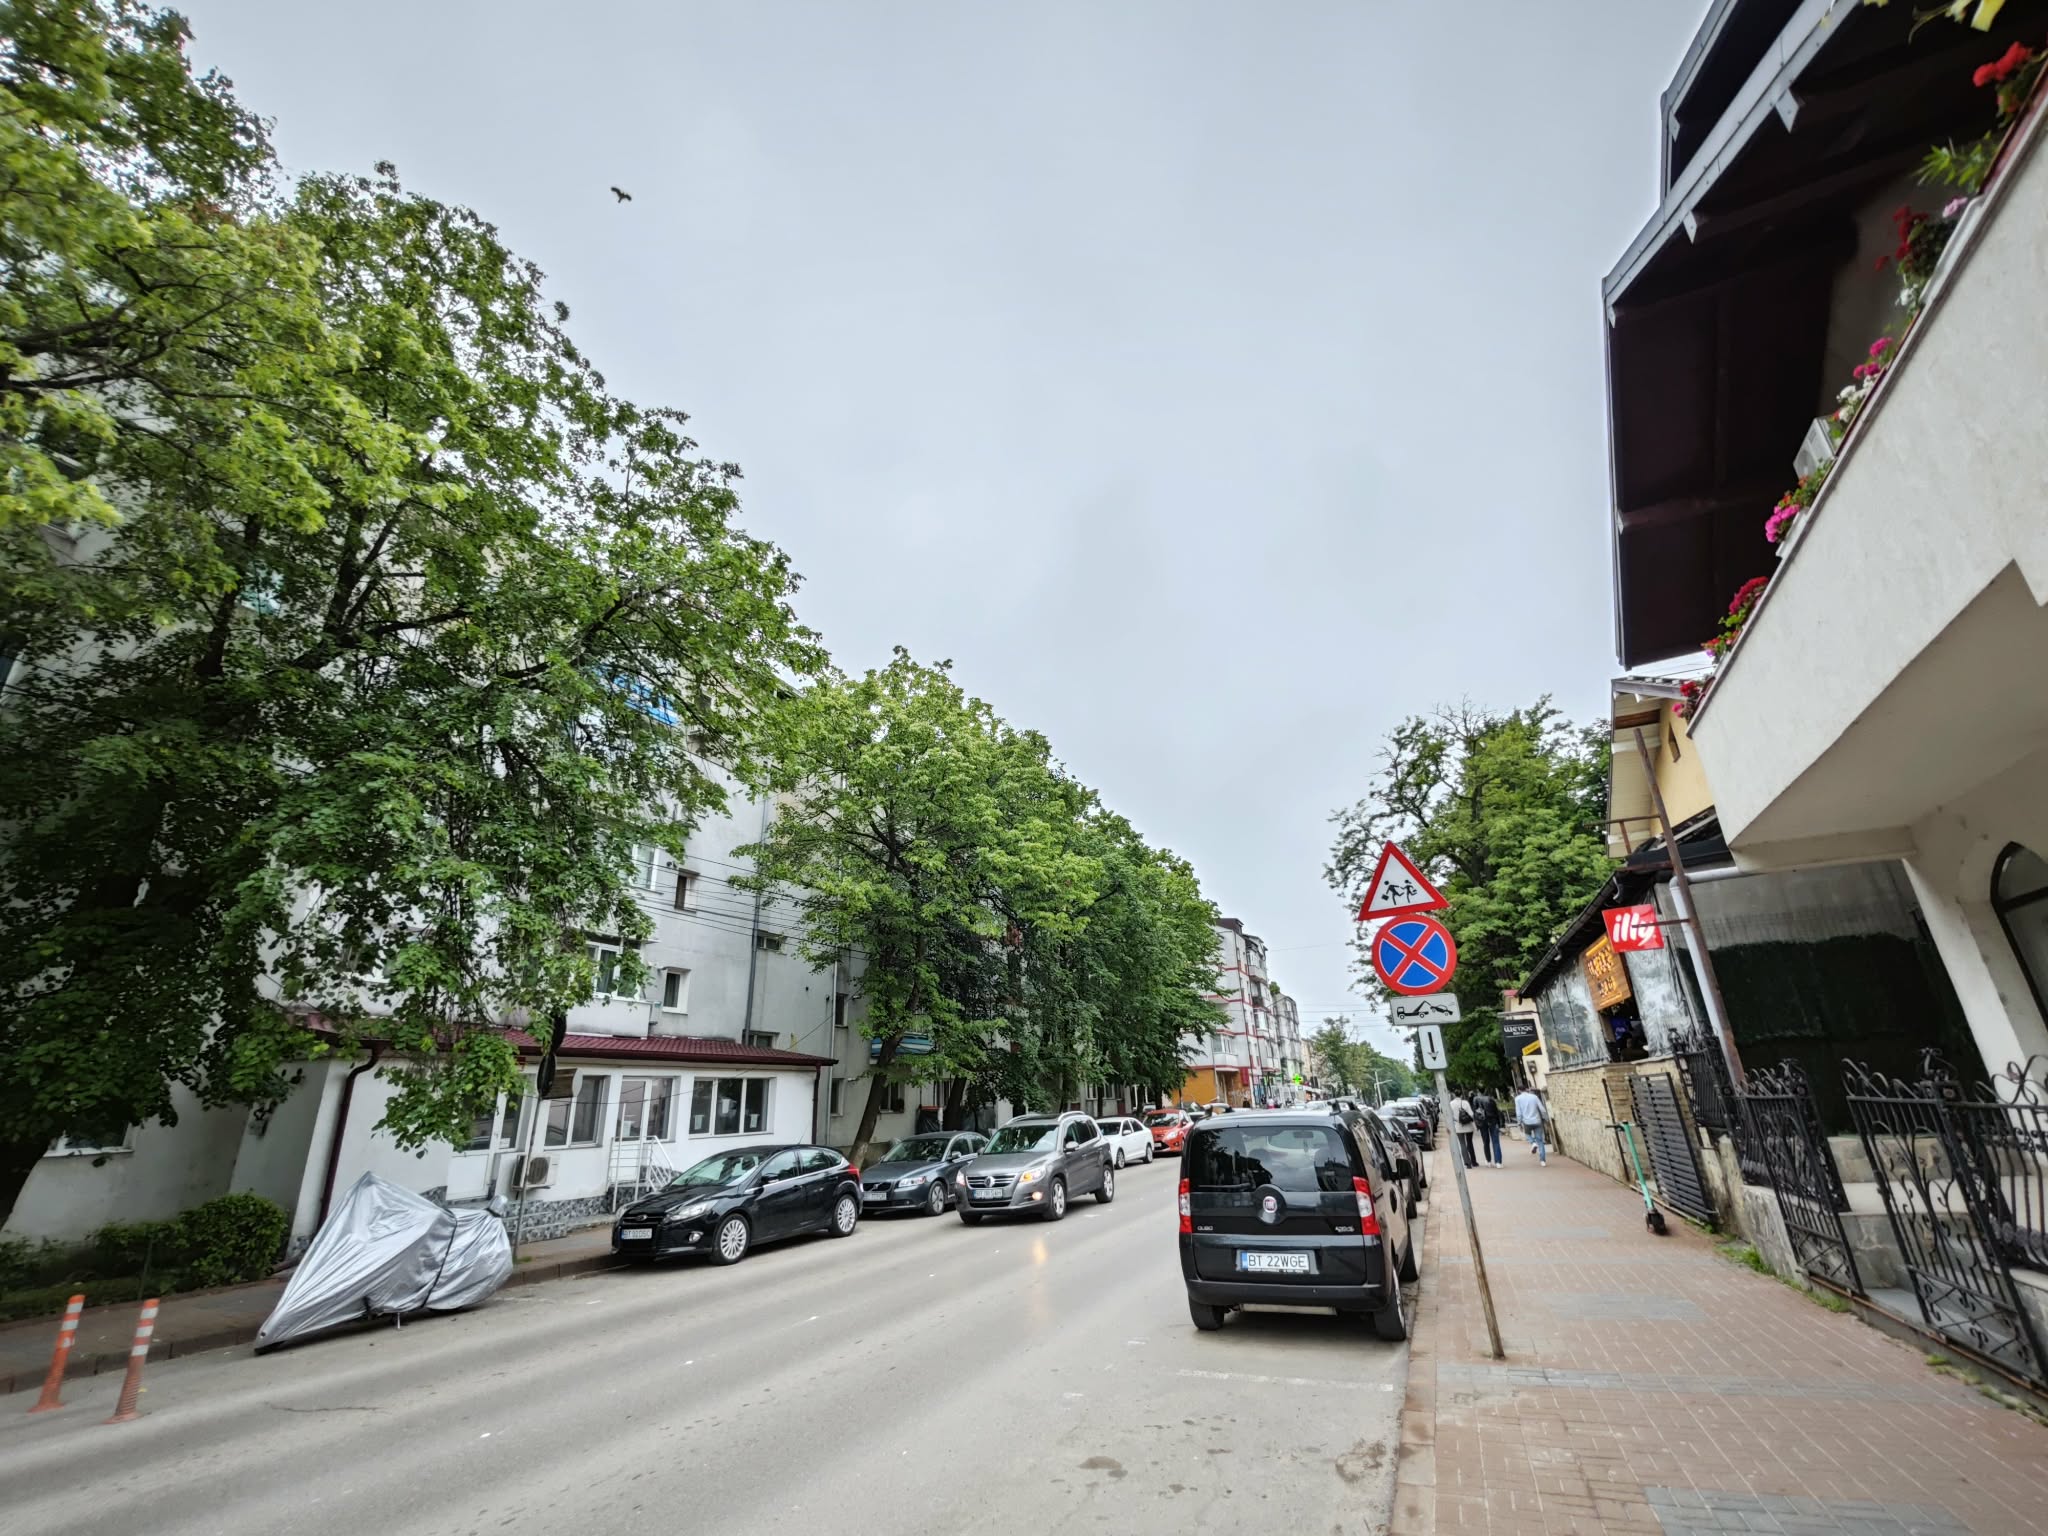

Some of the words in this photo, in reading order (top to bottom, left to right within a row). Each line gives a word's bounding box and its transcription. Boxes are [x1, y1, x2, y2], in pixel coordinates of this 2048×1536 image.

[1612, 912, 1655, 947] illy
[1248, 1254, 1263, 1267] BT
[1267, 1255, 1307, 1268] 22WGE
